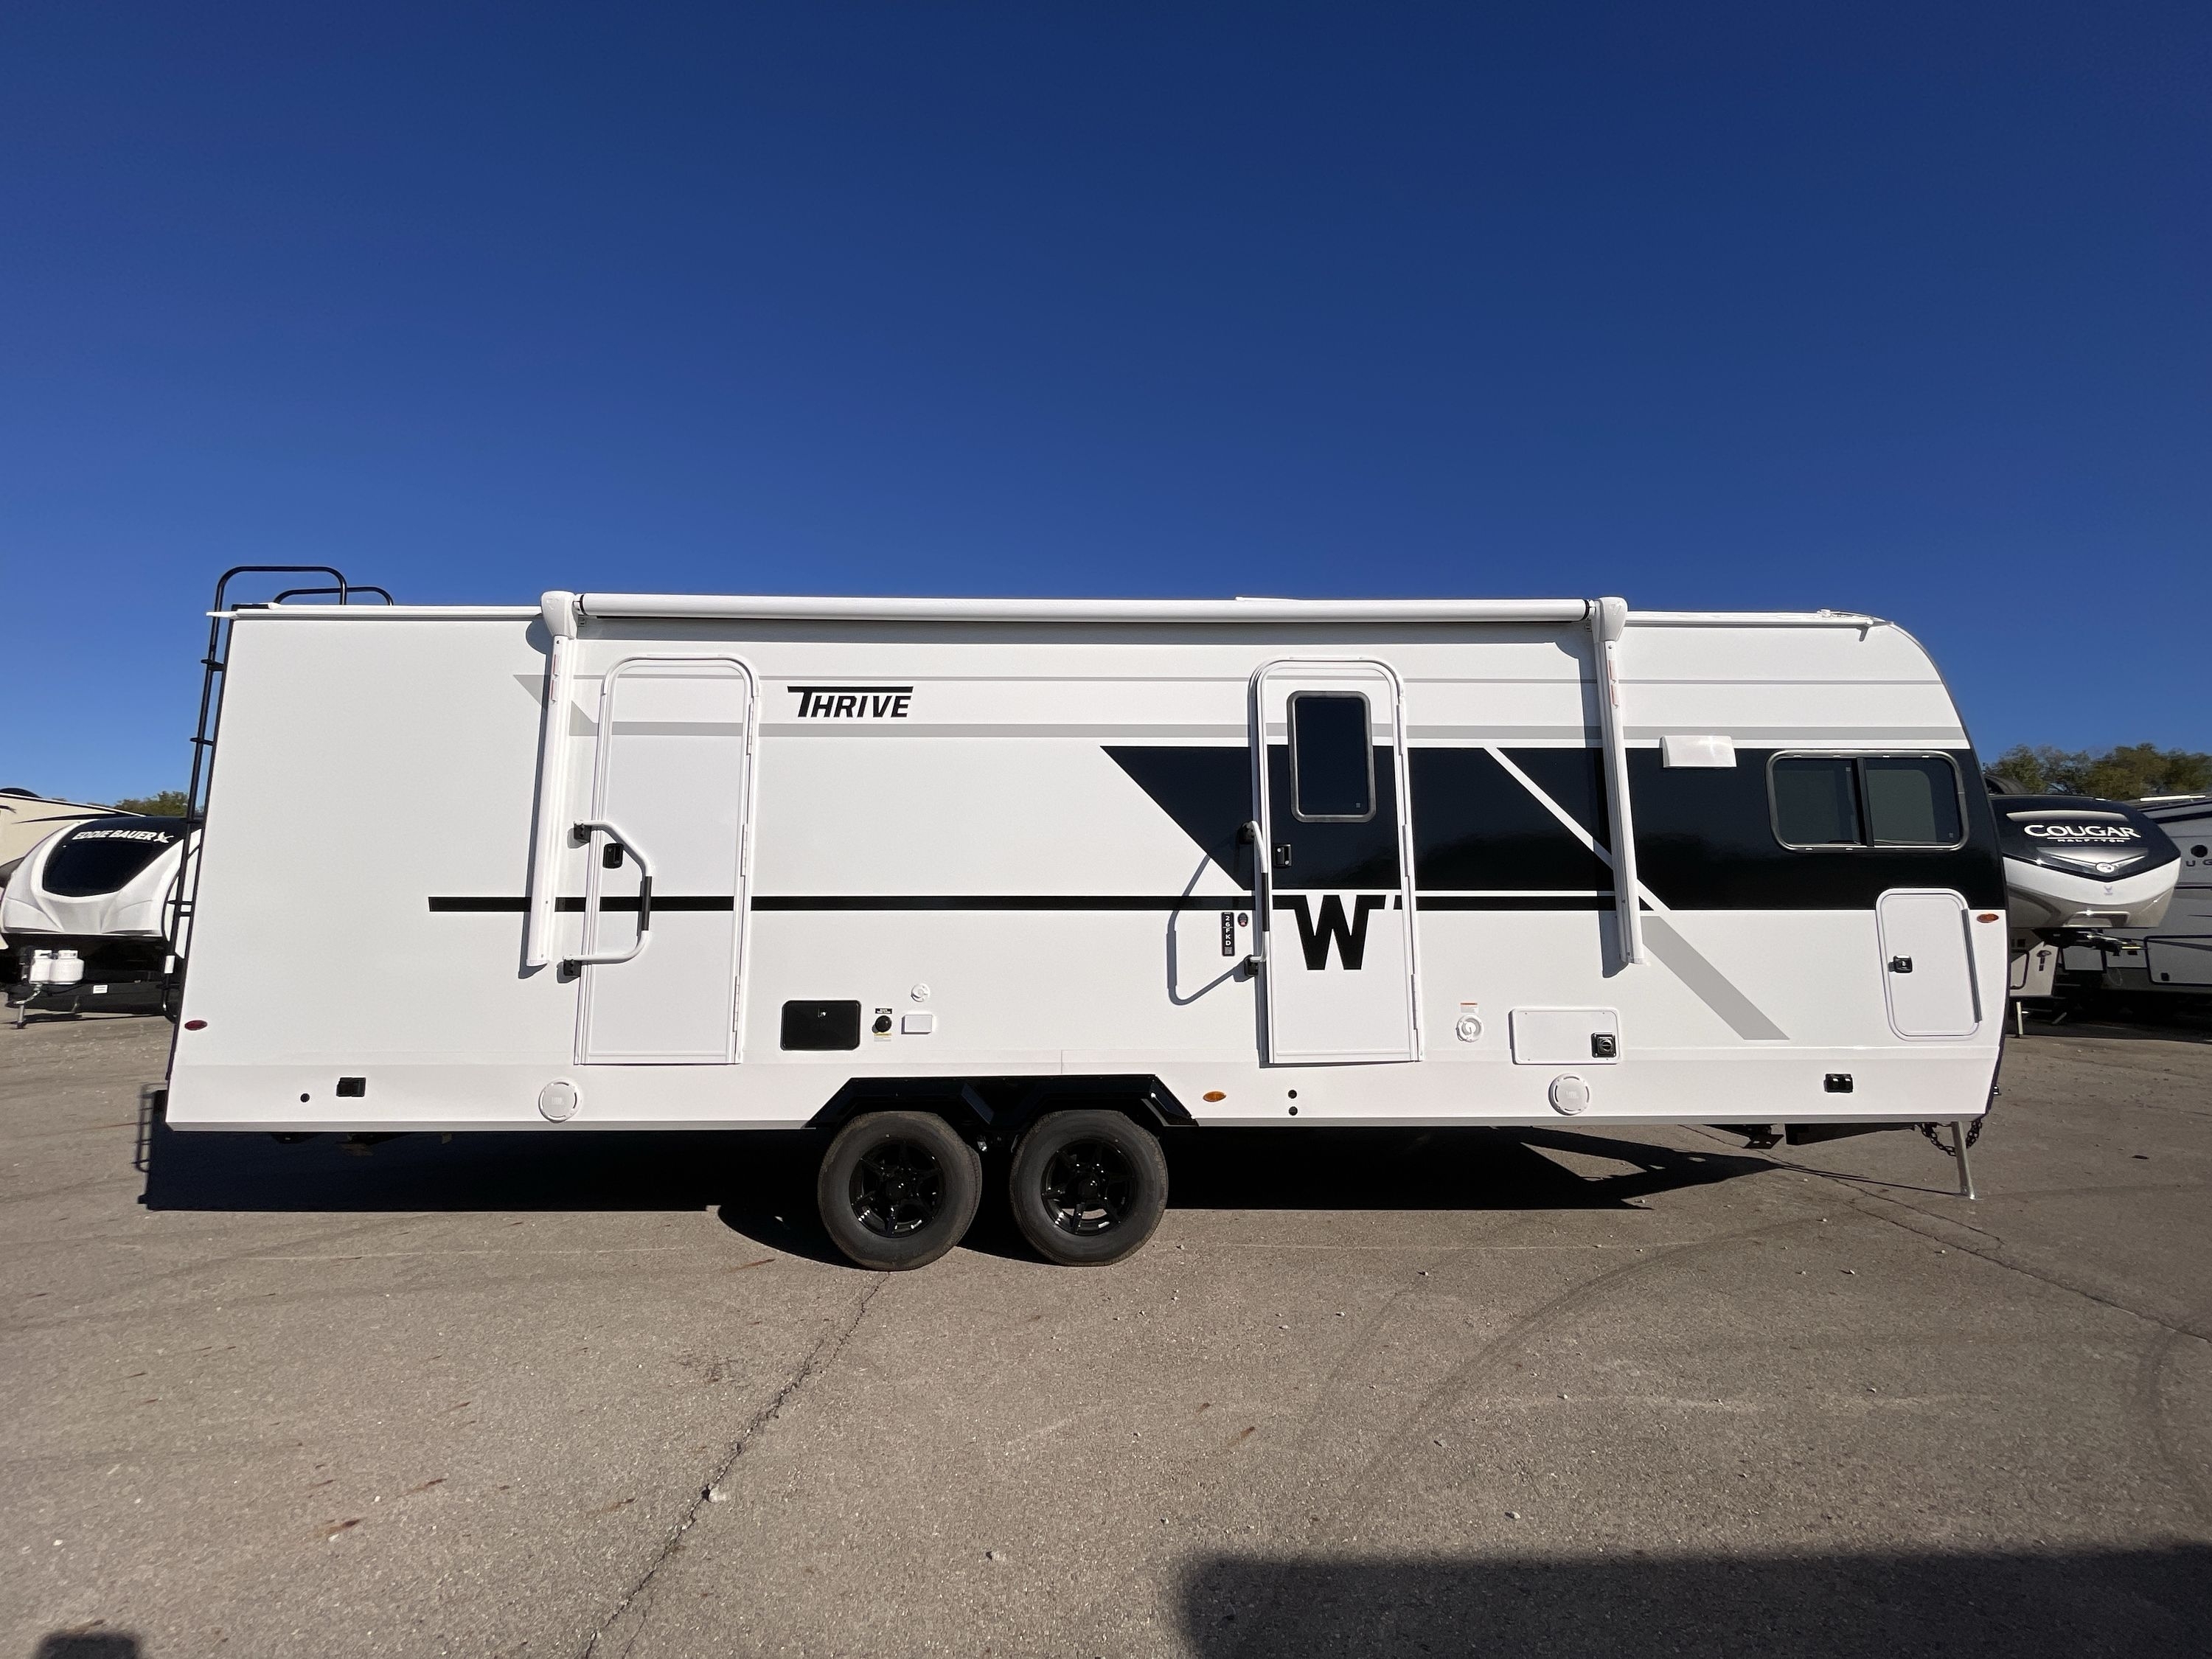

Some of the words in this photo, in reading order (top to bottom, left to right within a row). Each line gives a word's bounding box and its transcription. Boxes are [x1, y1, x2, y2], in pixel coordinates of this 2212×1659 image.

[787, 686, 914, 717] THRIVE
[72, 830, 114, 841] EDDIE
[108, 830, 158, 841] BAUER
[2023, 824, 2142, 838] COUGAR
[1272, 894, 1387, 970] W
